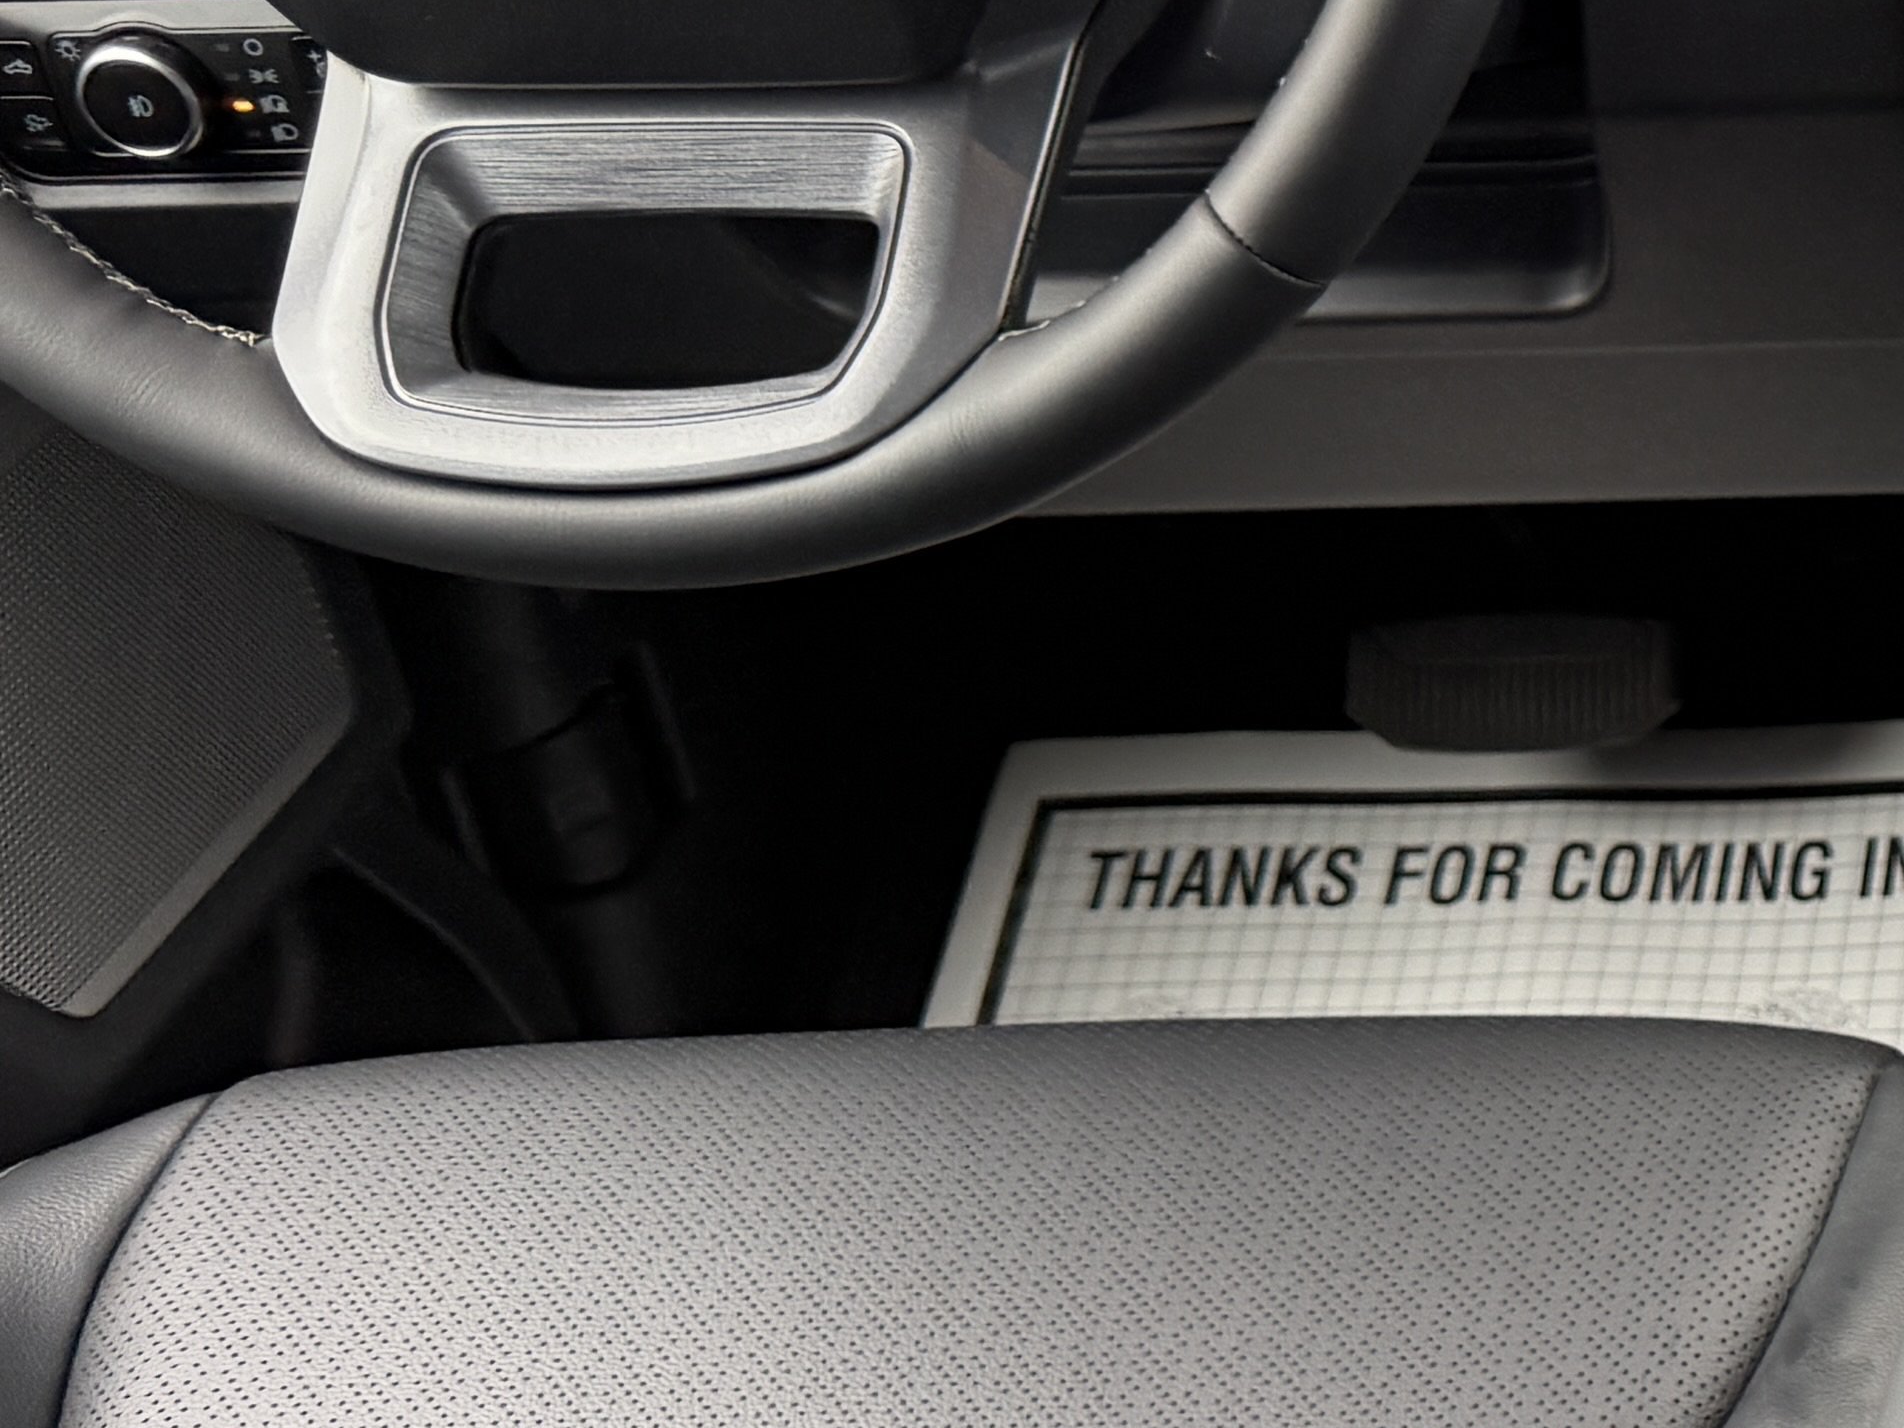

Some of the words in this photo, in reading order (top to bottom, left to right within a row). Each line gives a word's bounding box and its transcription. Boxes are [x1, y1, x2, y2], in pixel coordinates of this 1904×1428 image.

[1088, 844, 1362, 912] THANKS
[1384, 840, 1527, 906] FOR
[1550, 835, 1836, 906] COMING
